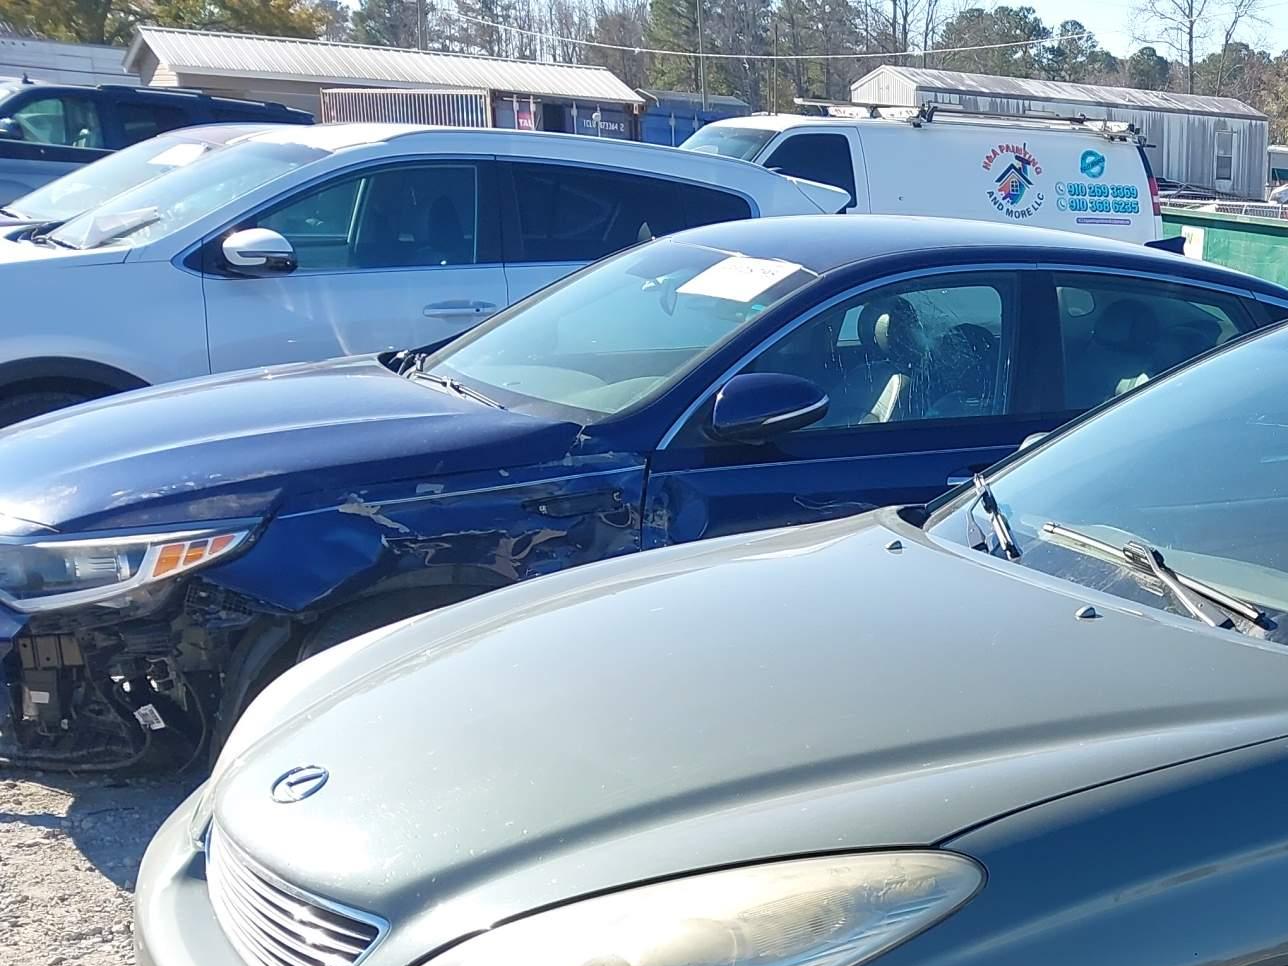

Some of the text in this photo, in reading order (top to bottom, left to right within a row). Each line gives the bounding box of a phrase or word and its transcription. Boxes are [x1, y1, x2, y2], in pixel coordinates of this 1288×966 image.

[998, 143, 1042, 176] PAINTING
[1067, 182, 1138, 199] 910 269 3369
[986, 190, 1045, 220] AND MORE LLC
[1068, 197, 1139, 214] 910 368 6235
